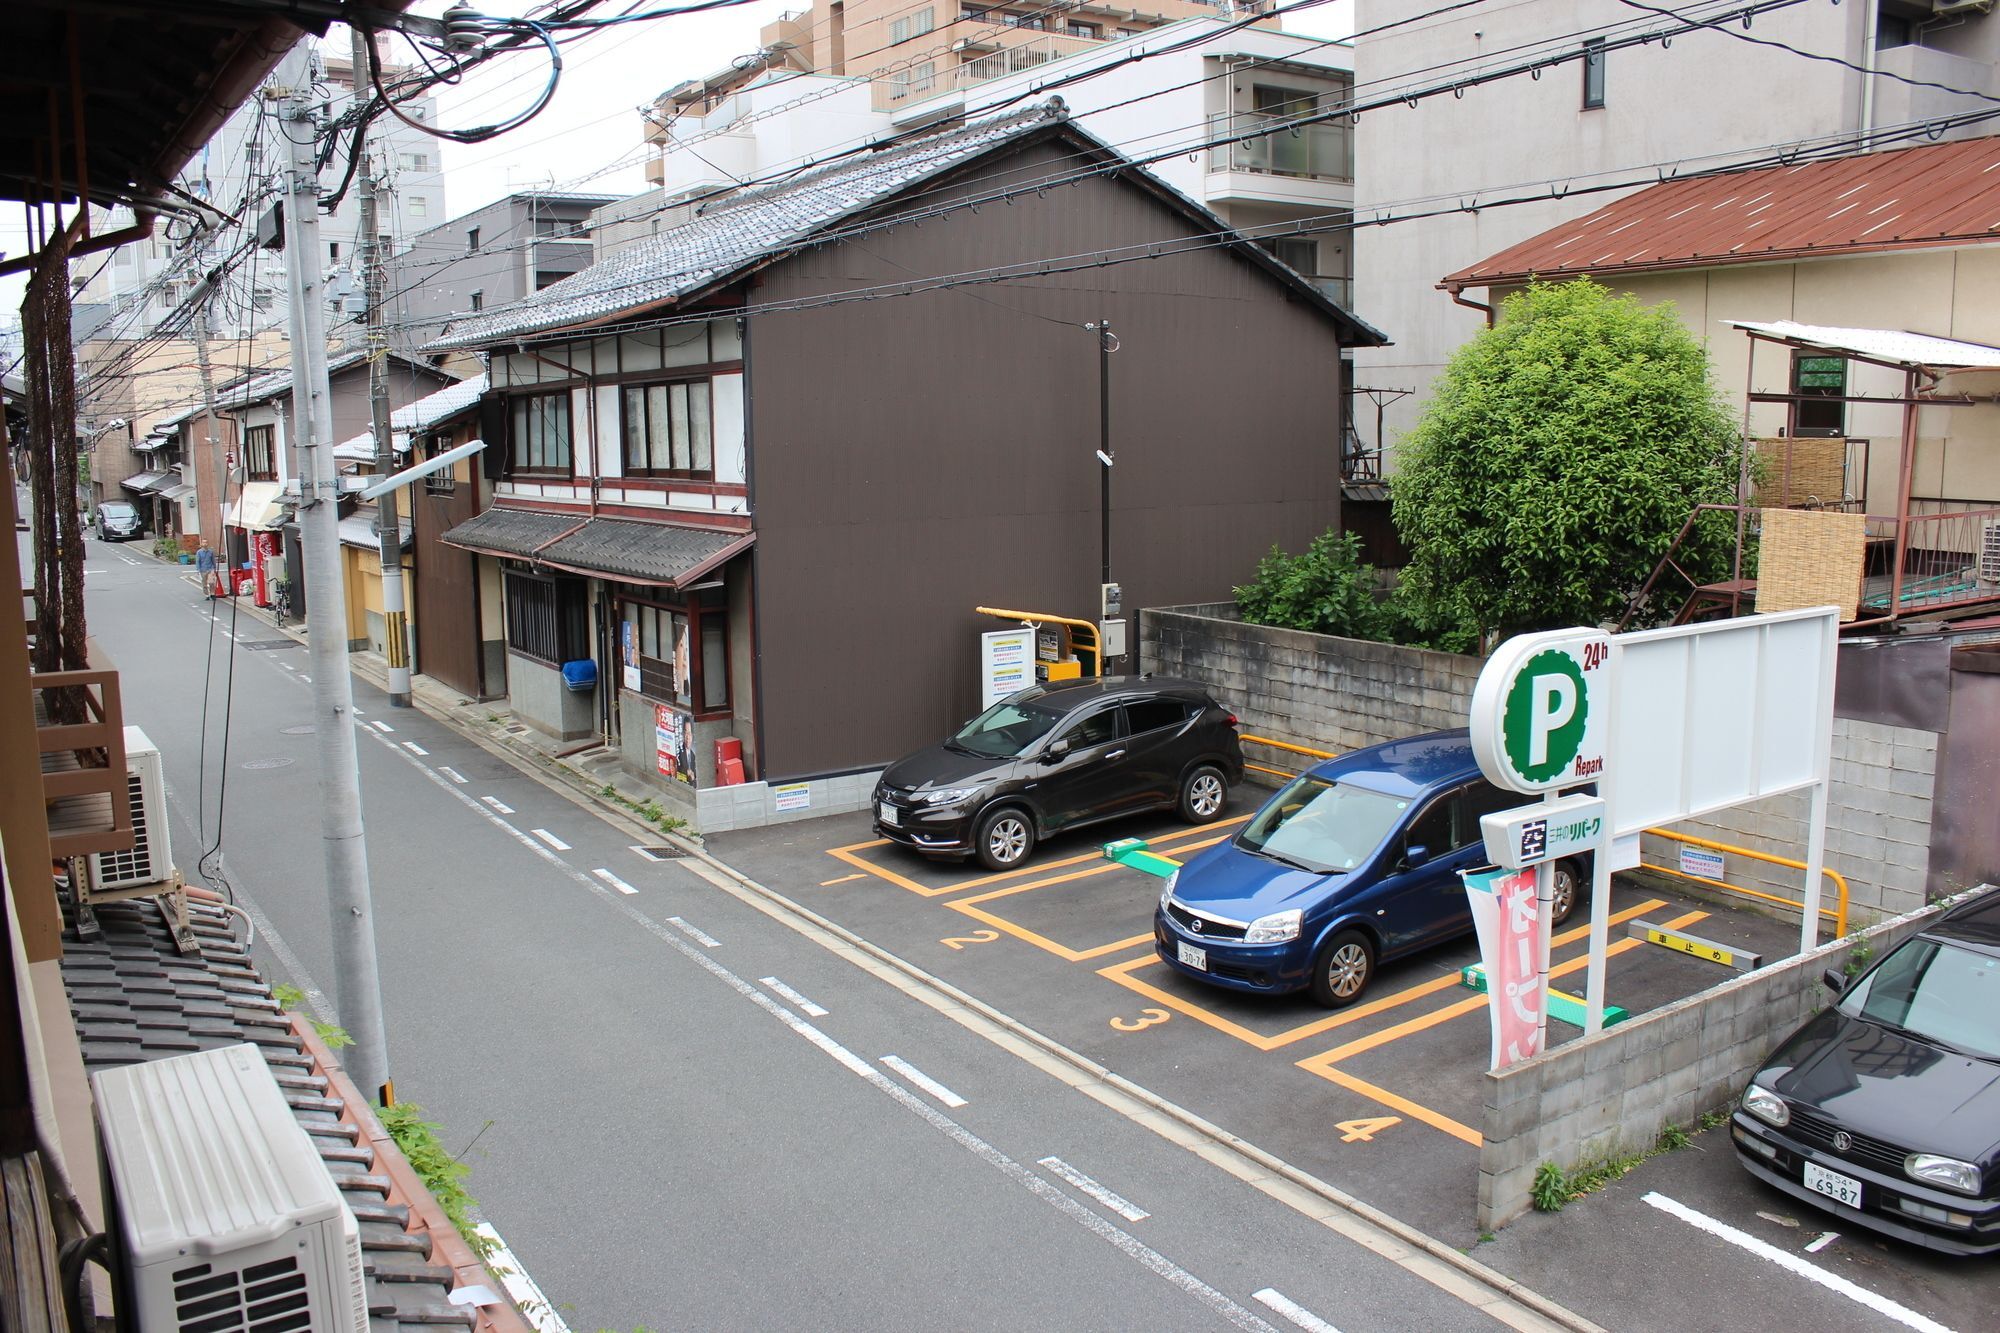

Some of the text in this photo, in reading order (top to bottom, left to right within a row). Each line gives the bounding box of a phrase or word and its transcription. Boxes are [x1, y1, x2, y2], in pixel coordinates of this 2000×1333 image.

[1584, 641, 1608, 671] 24h
[1528, 672, 1577, 767] P
[1575, 755, 1604, 778] Repark
[1521, 821, 1545, 861] 空
[820, 874, 868, 886] 1
[940, 930, 999, 950] 2
[1109, 1008, 1171, 1031] 3
[1333, 1116, 1403, 1143] 4
[1816, 1179, 1858, 1204] 69-87
